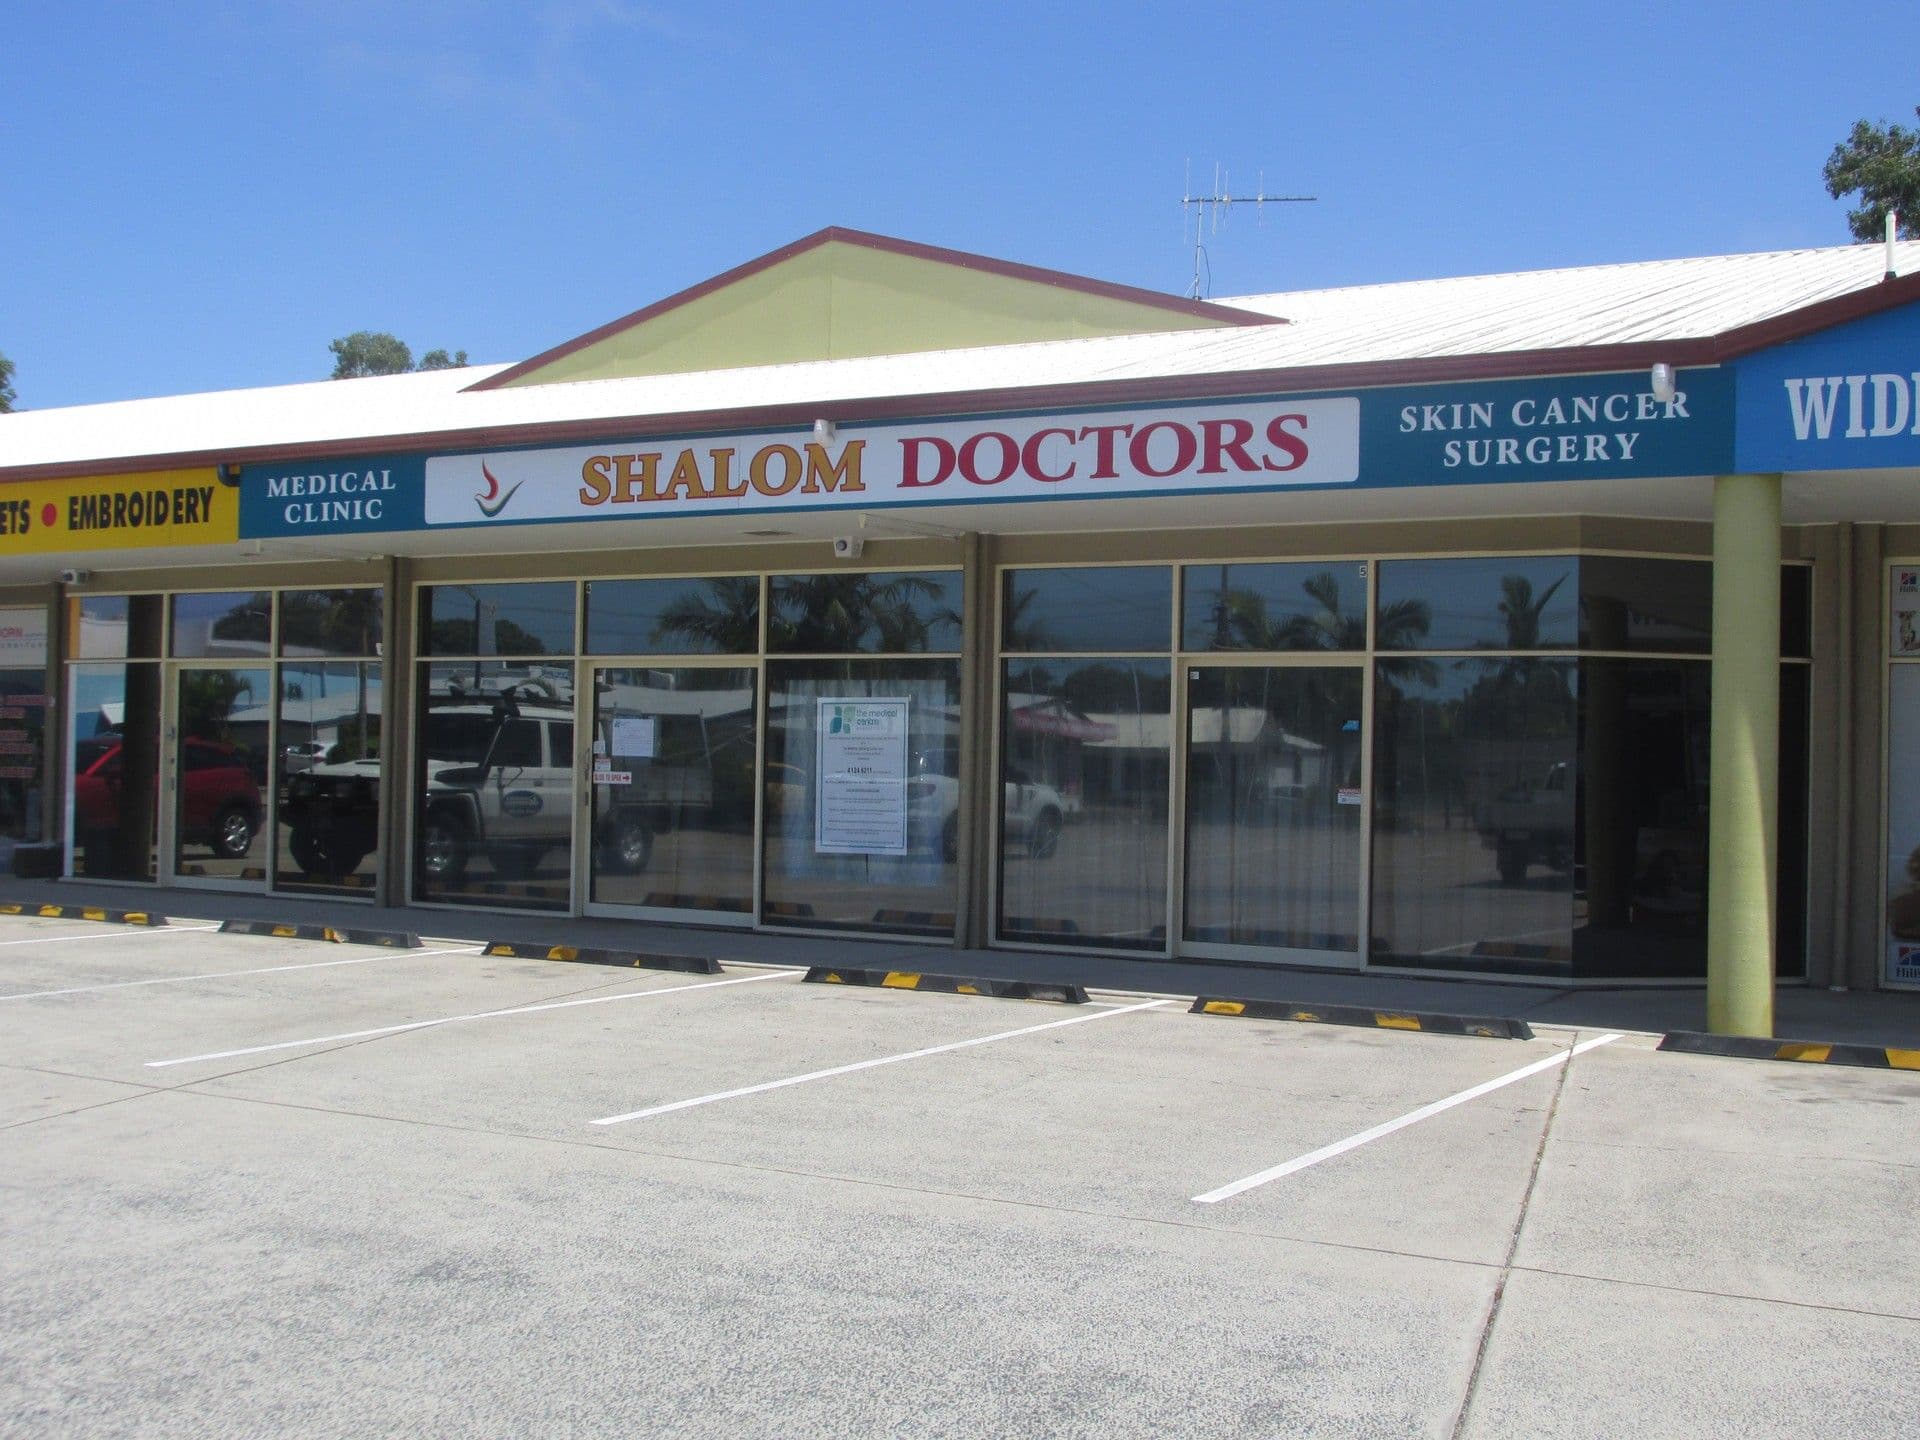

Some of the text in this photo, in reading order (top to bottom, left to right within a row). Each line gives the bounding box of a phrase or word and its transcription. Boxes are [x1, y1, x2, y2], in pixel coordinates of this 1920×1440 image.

[1400, 391, 1690, 433] SKIN CANCER
[579, 413, 1309, 507] SHALOM DOCTORS
[1442, 432, 1641, 469] SURGERY
[267, 469, 396, 498] MEDICAL
[68, 486, 215, 531] EMBROIDERY
[284, 497, 383, 525] CLINIC
[1359, 567, 1367, 576] 5
